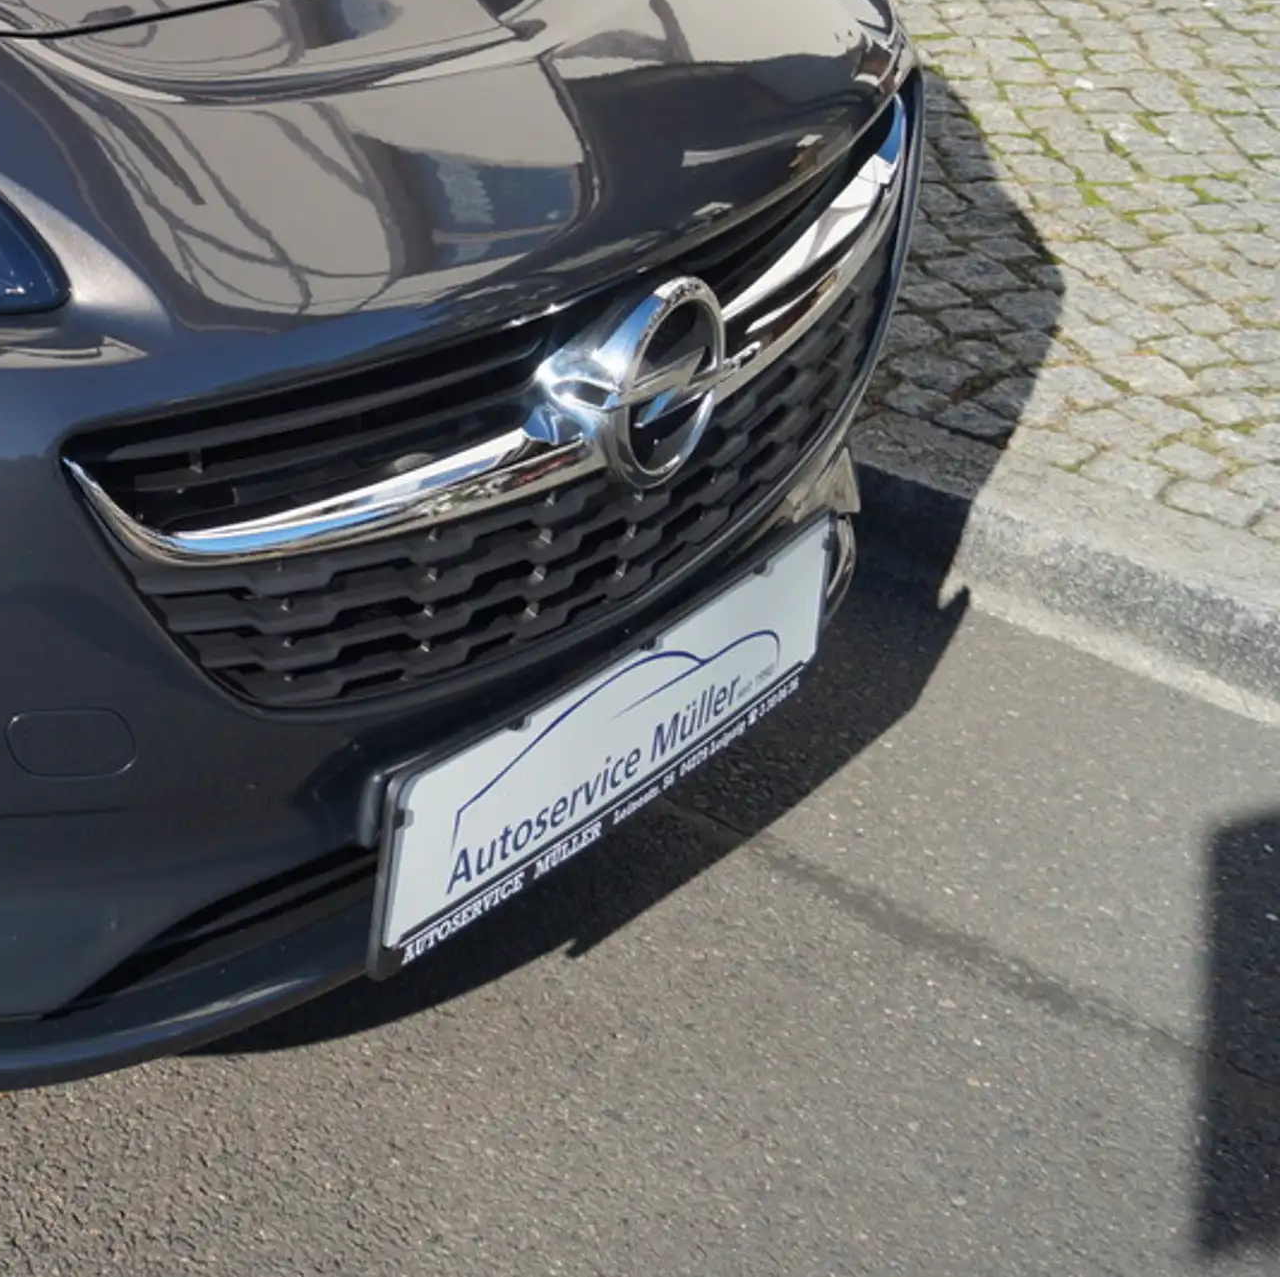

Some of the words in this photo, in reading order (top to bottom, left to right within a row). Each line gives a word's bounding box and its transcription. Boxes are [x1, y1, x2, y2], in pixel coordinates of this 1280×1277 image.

[446, 748, 641, 895] Autoservice
[651, 674, 741, 763] Müller
[401, 871, 526, 966] AUTOSERVICE
[533, 822, 604, 880] MÜLLER
